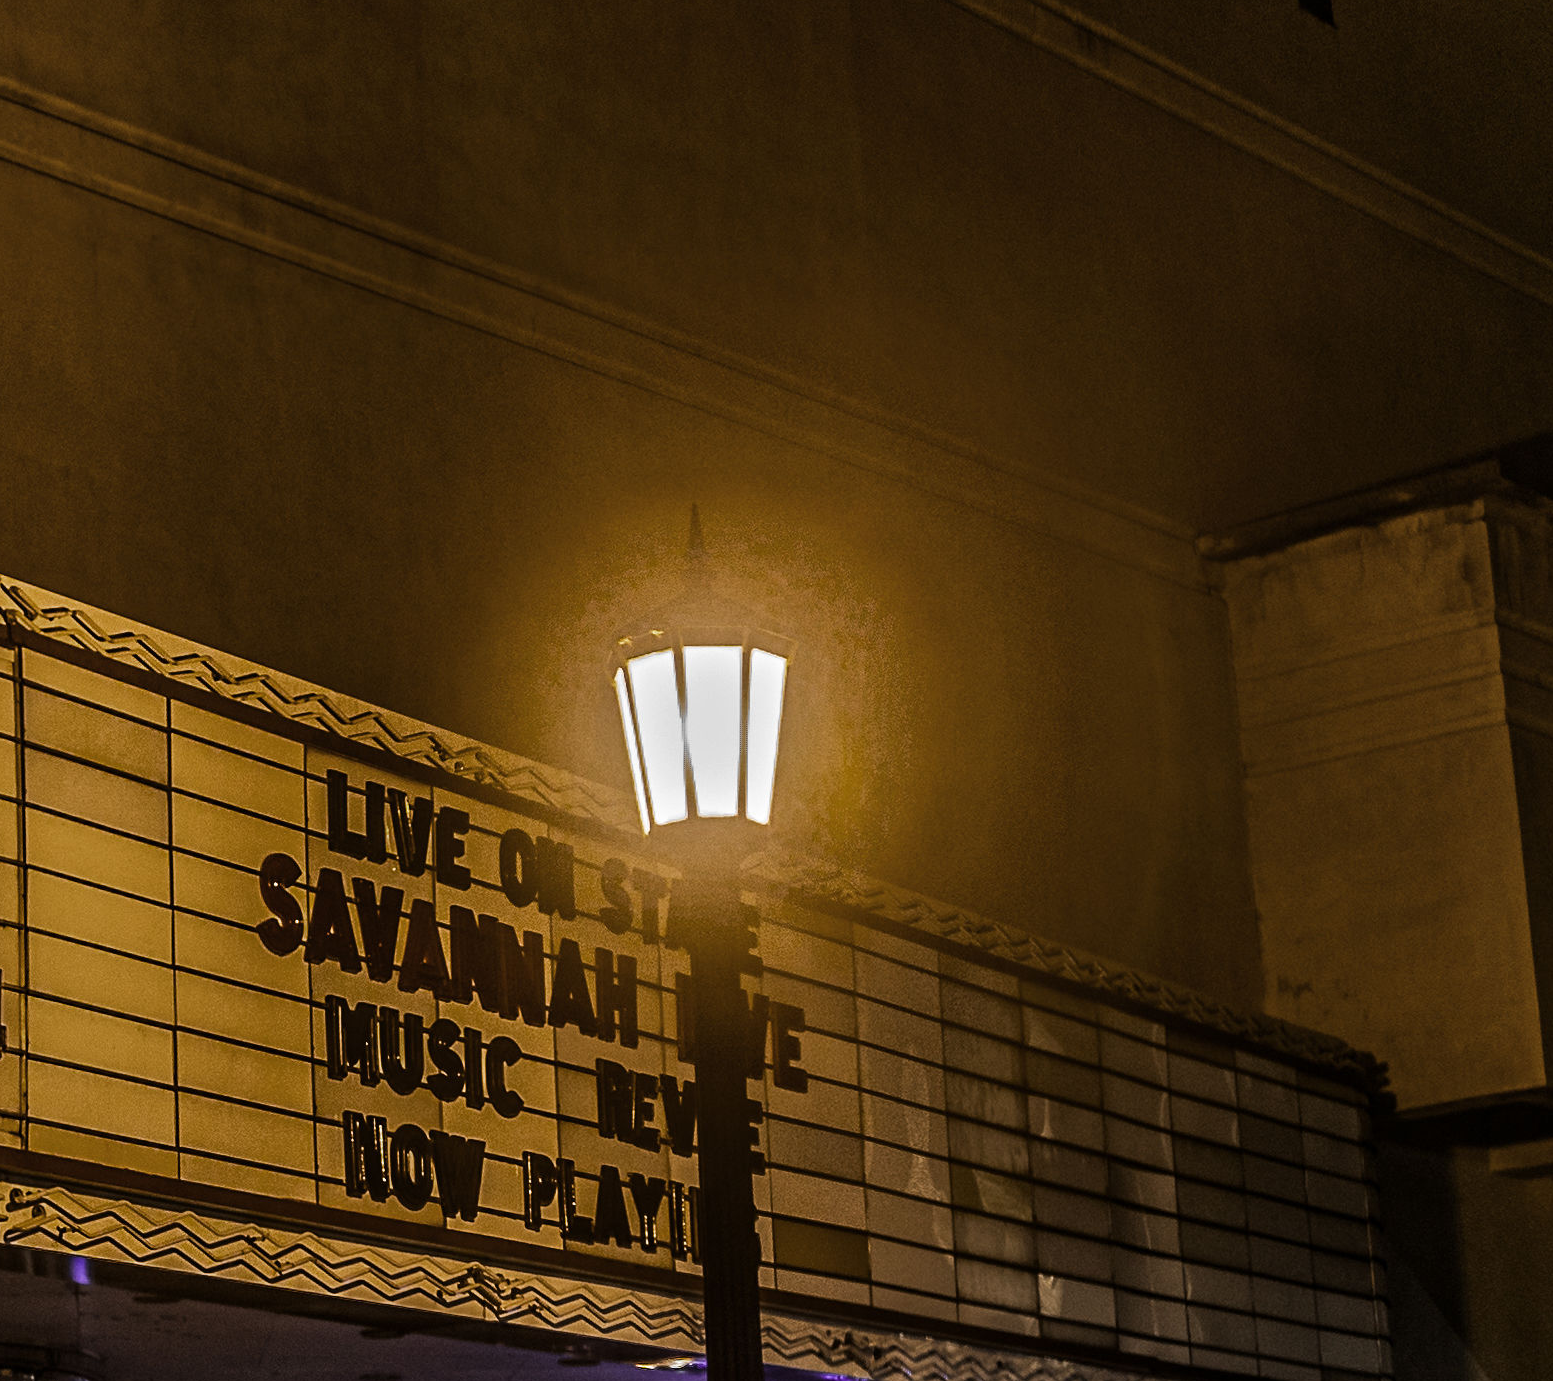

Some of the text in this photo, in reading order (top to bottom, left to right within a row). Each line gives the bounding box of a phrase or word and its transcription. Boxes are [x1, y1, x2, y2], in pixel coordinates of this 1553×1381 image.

[326, 768, 472, 890] LIVE
[499, 828, 577, 918] ON
[256, 852, 639, 1051] SAVANNAH
[325, 994, 766, 1176] MUSIC REVE
[342, 1110, 486, 1222] NOW
